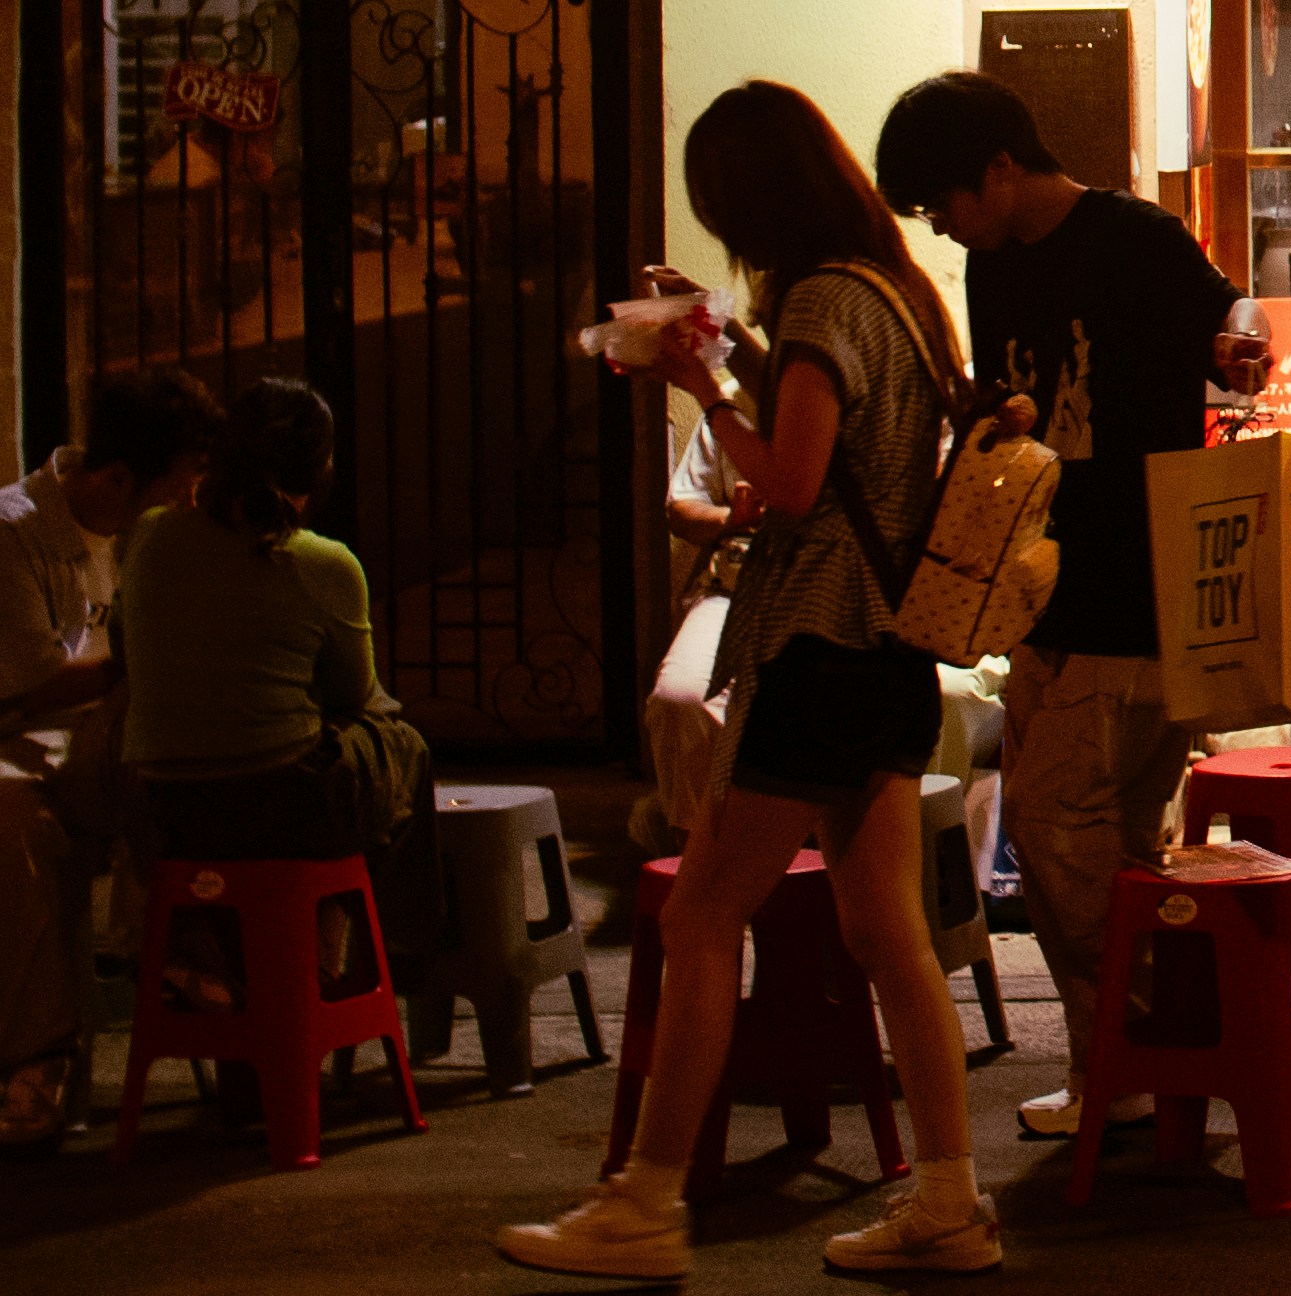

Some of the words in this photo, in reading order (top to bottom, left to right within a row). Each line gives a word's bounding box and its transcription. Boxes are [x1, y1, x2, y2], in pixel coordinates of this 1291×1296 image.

[177, 75, 264, 123] OPEN
[1196, 513, 1249, 572] TOP
[1195, 573, 1243, 630] TOY
